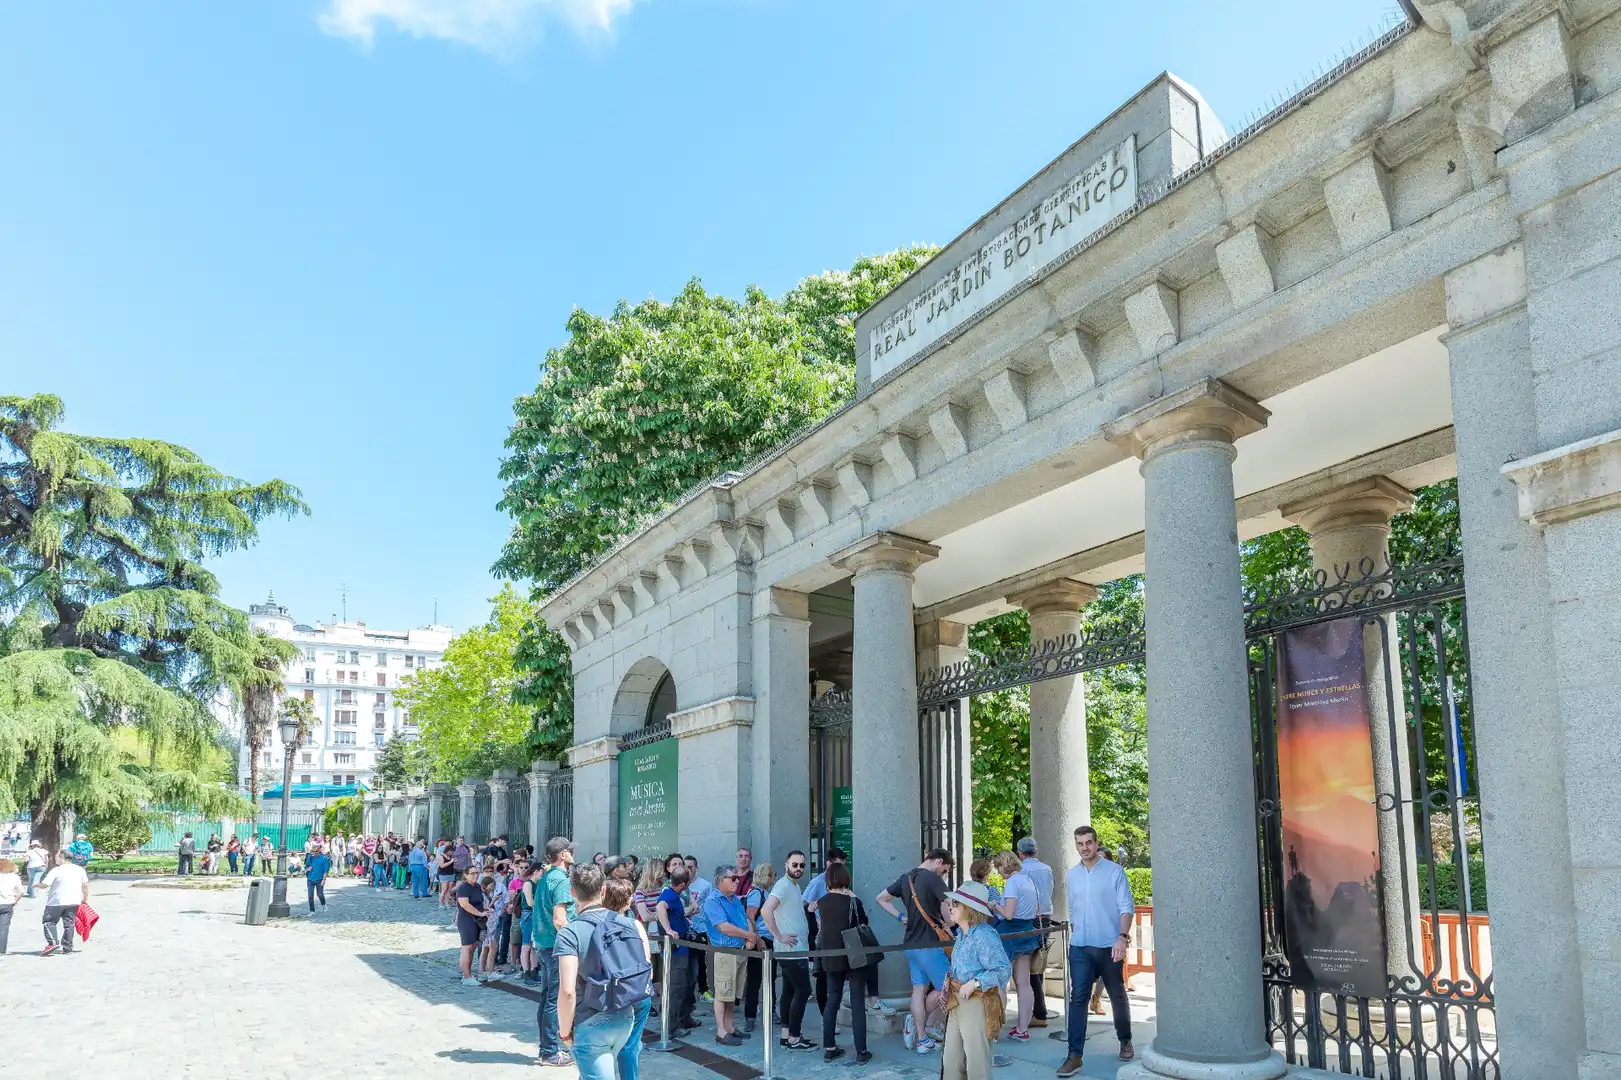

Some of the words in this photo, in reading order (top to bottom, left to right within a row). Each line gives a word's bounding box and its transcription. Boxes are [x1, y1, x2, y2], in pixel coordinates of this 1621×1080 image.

[1044, 160, 1107, 214] CIENTIFICAS
[875, 319, 917, 361] REAL
[926, 261, 992, 324] JARDIN
[1003, 164, 1128, 270] BOTANICO
[1326, 682, 1361, 694] ESTRELLAS
[630, 780, 665, 800] MÚSICA
